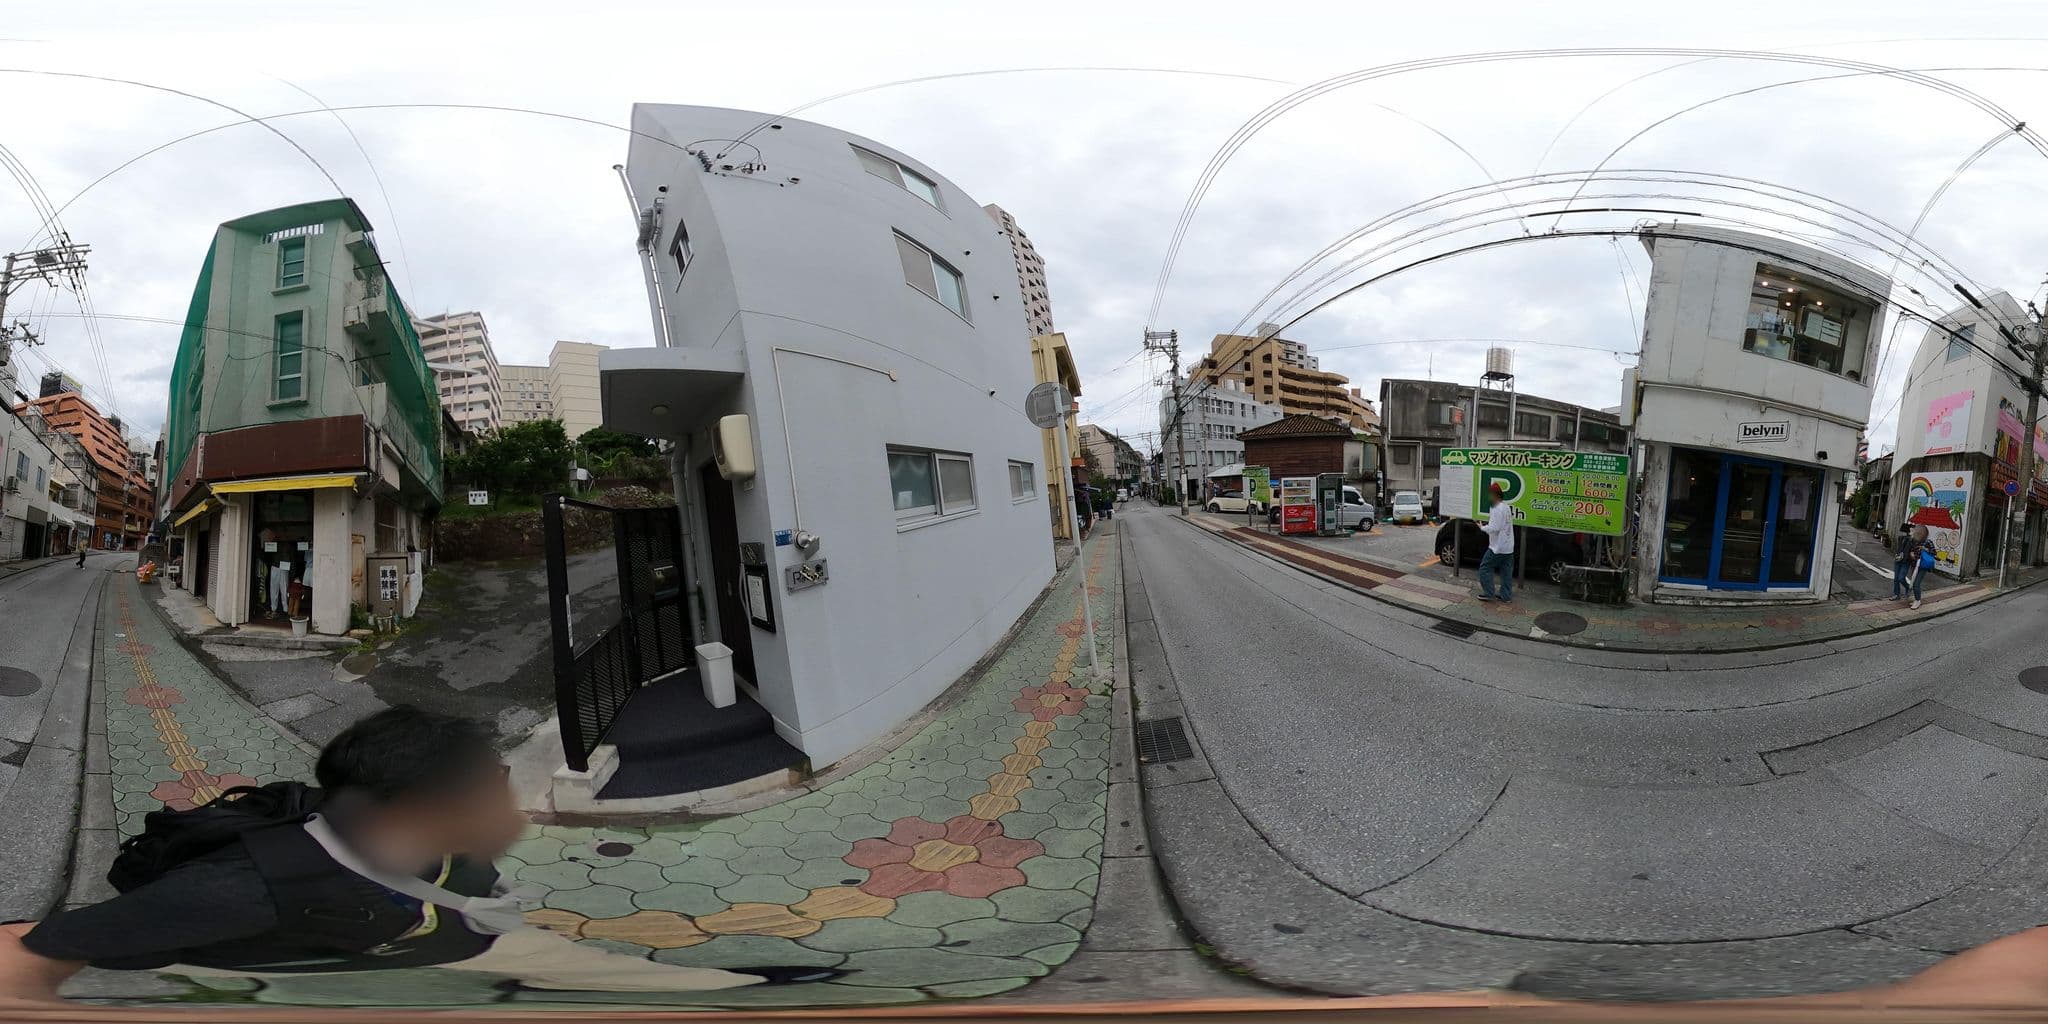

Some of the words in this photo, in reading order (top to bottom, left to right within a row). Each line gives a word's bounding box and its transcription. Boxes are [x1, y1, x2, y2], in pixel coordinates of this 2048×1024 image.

[1743, 424, 1785, 437] belyni
[1469, 451, 1576, 469] マツオKTパーキング
[1249, 479, 1256, 498] P
